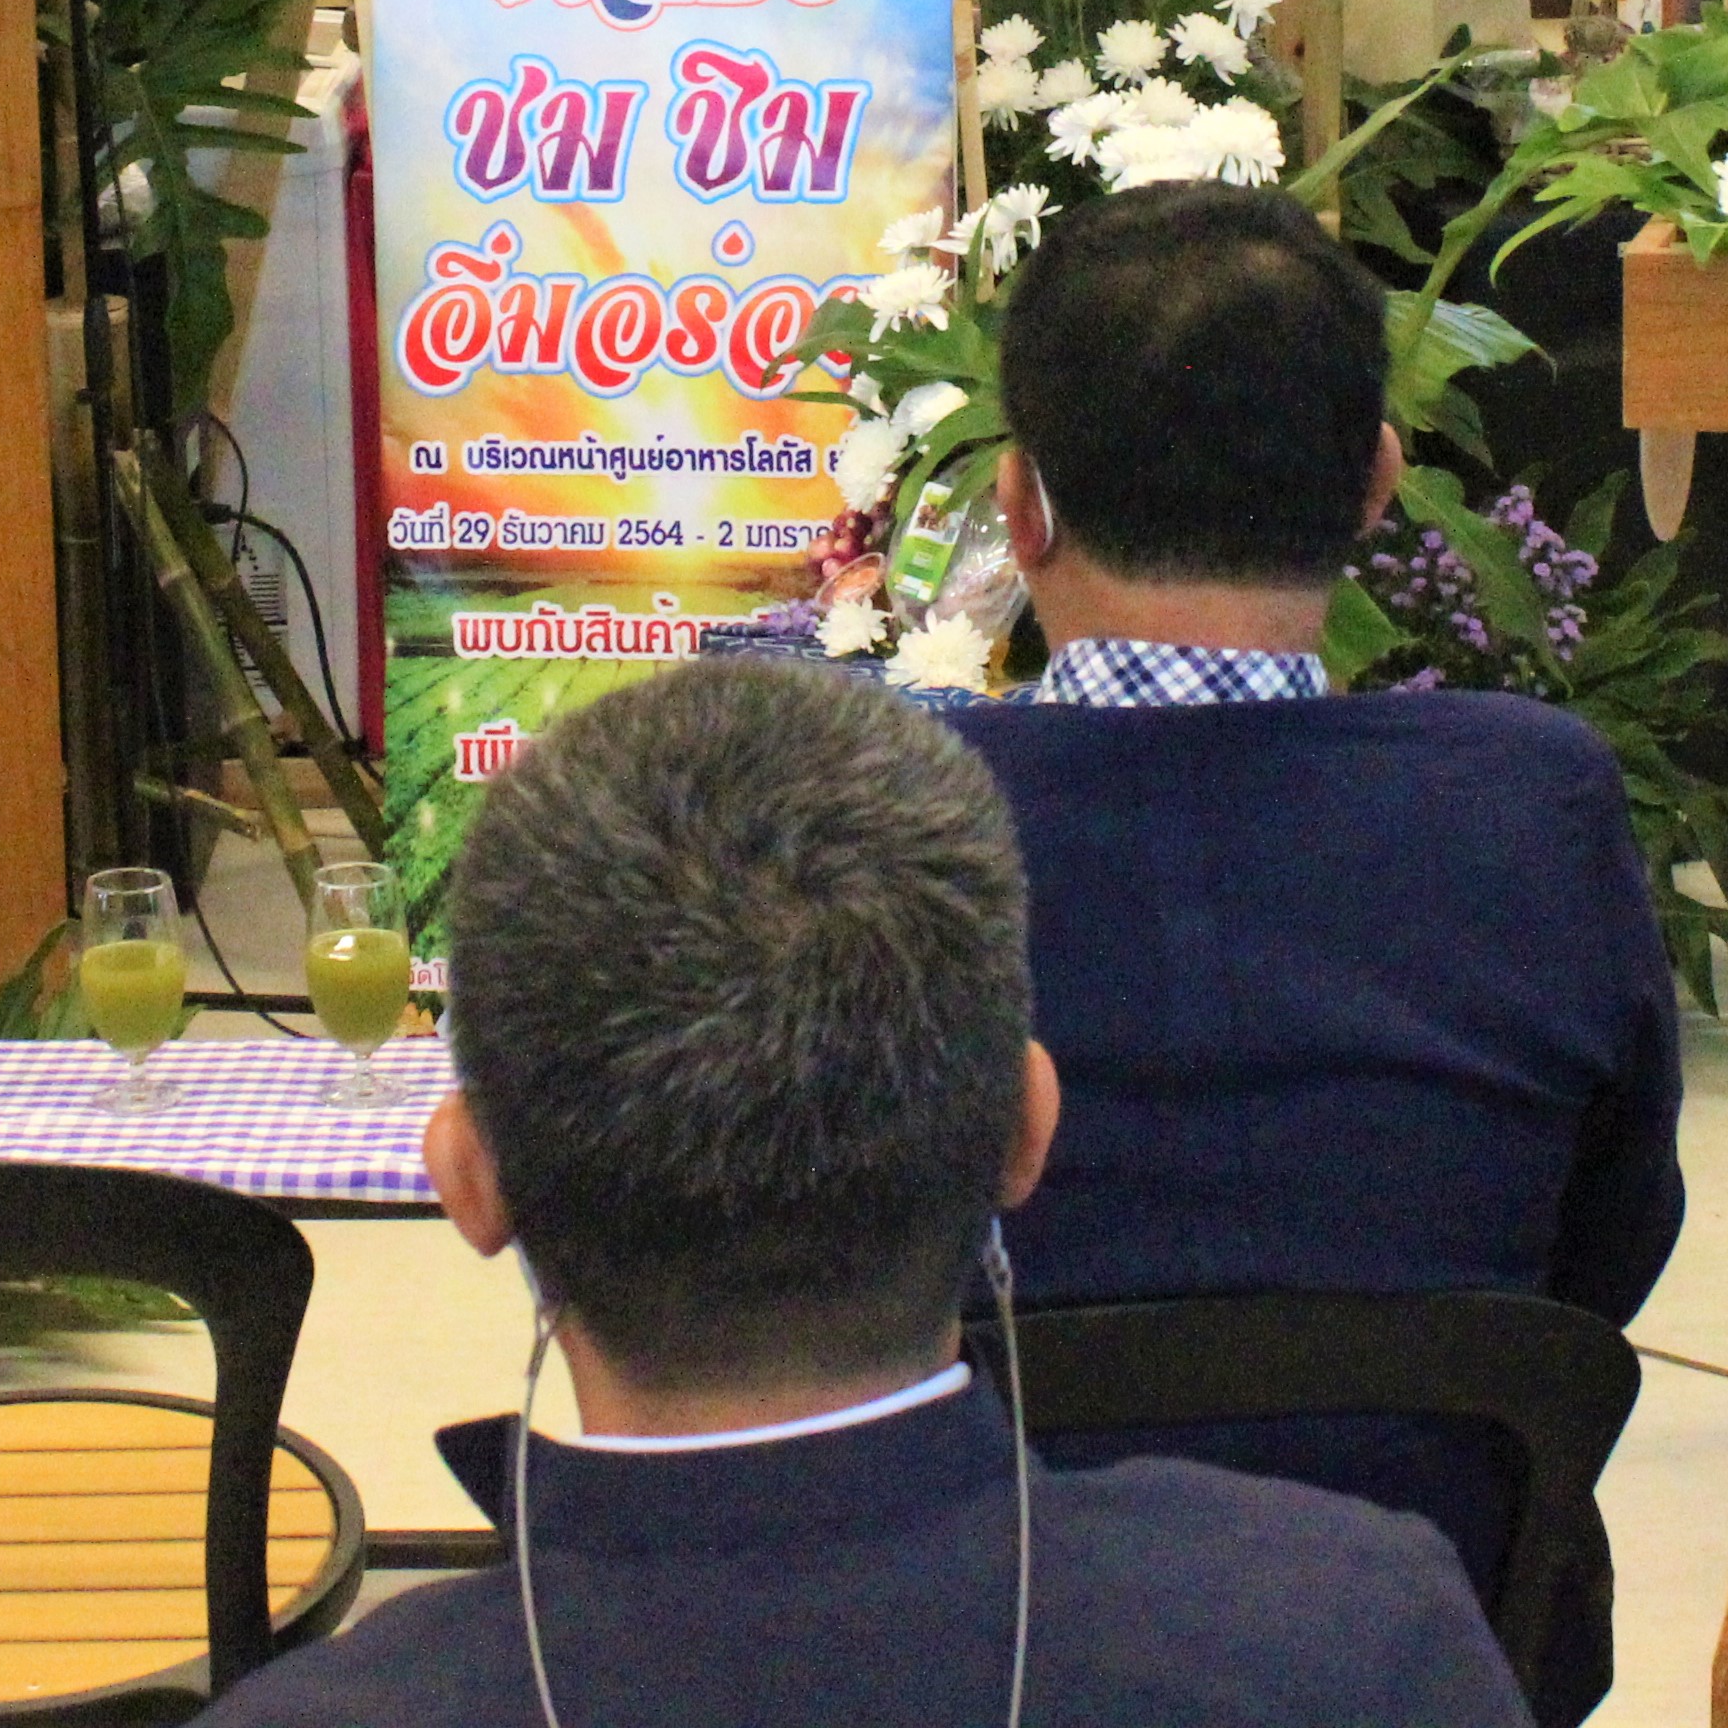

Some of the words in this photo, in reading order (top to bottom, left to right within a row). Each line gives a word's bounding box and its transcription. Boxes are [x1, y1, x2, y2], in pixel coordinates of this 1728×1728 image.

[451, 59, 642, 196] ชม
[672, 45, 867, 196] ชิม
[414, 443, 443, 470] ณ
[468, 434, 812, 480] บริเวณหน้าศูนย์อาหารโลตัส
[392, 507, 446, 545] วันที่
[458, 519, 490, 544] 29
[502, 514, 605, 545] ธันวาคม
[618, 519, 684, 545] 2564
[718, 519, 734, 545] 2
